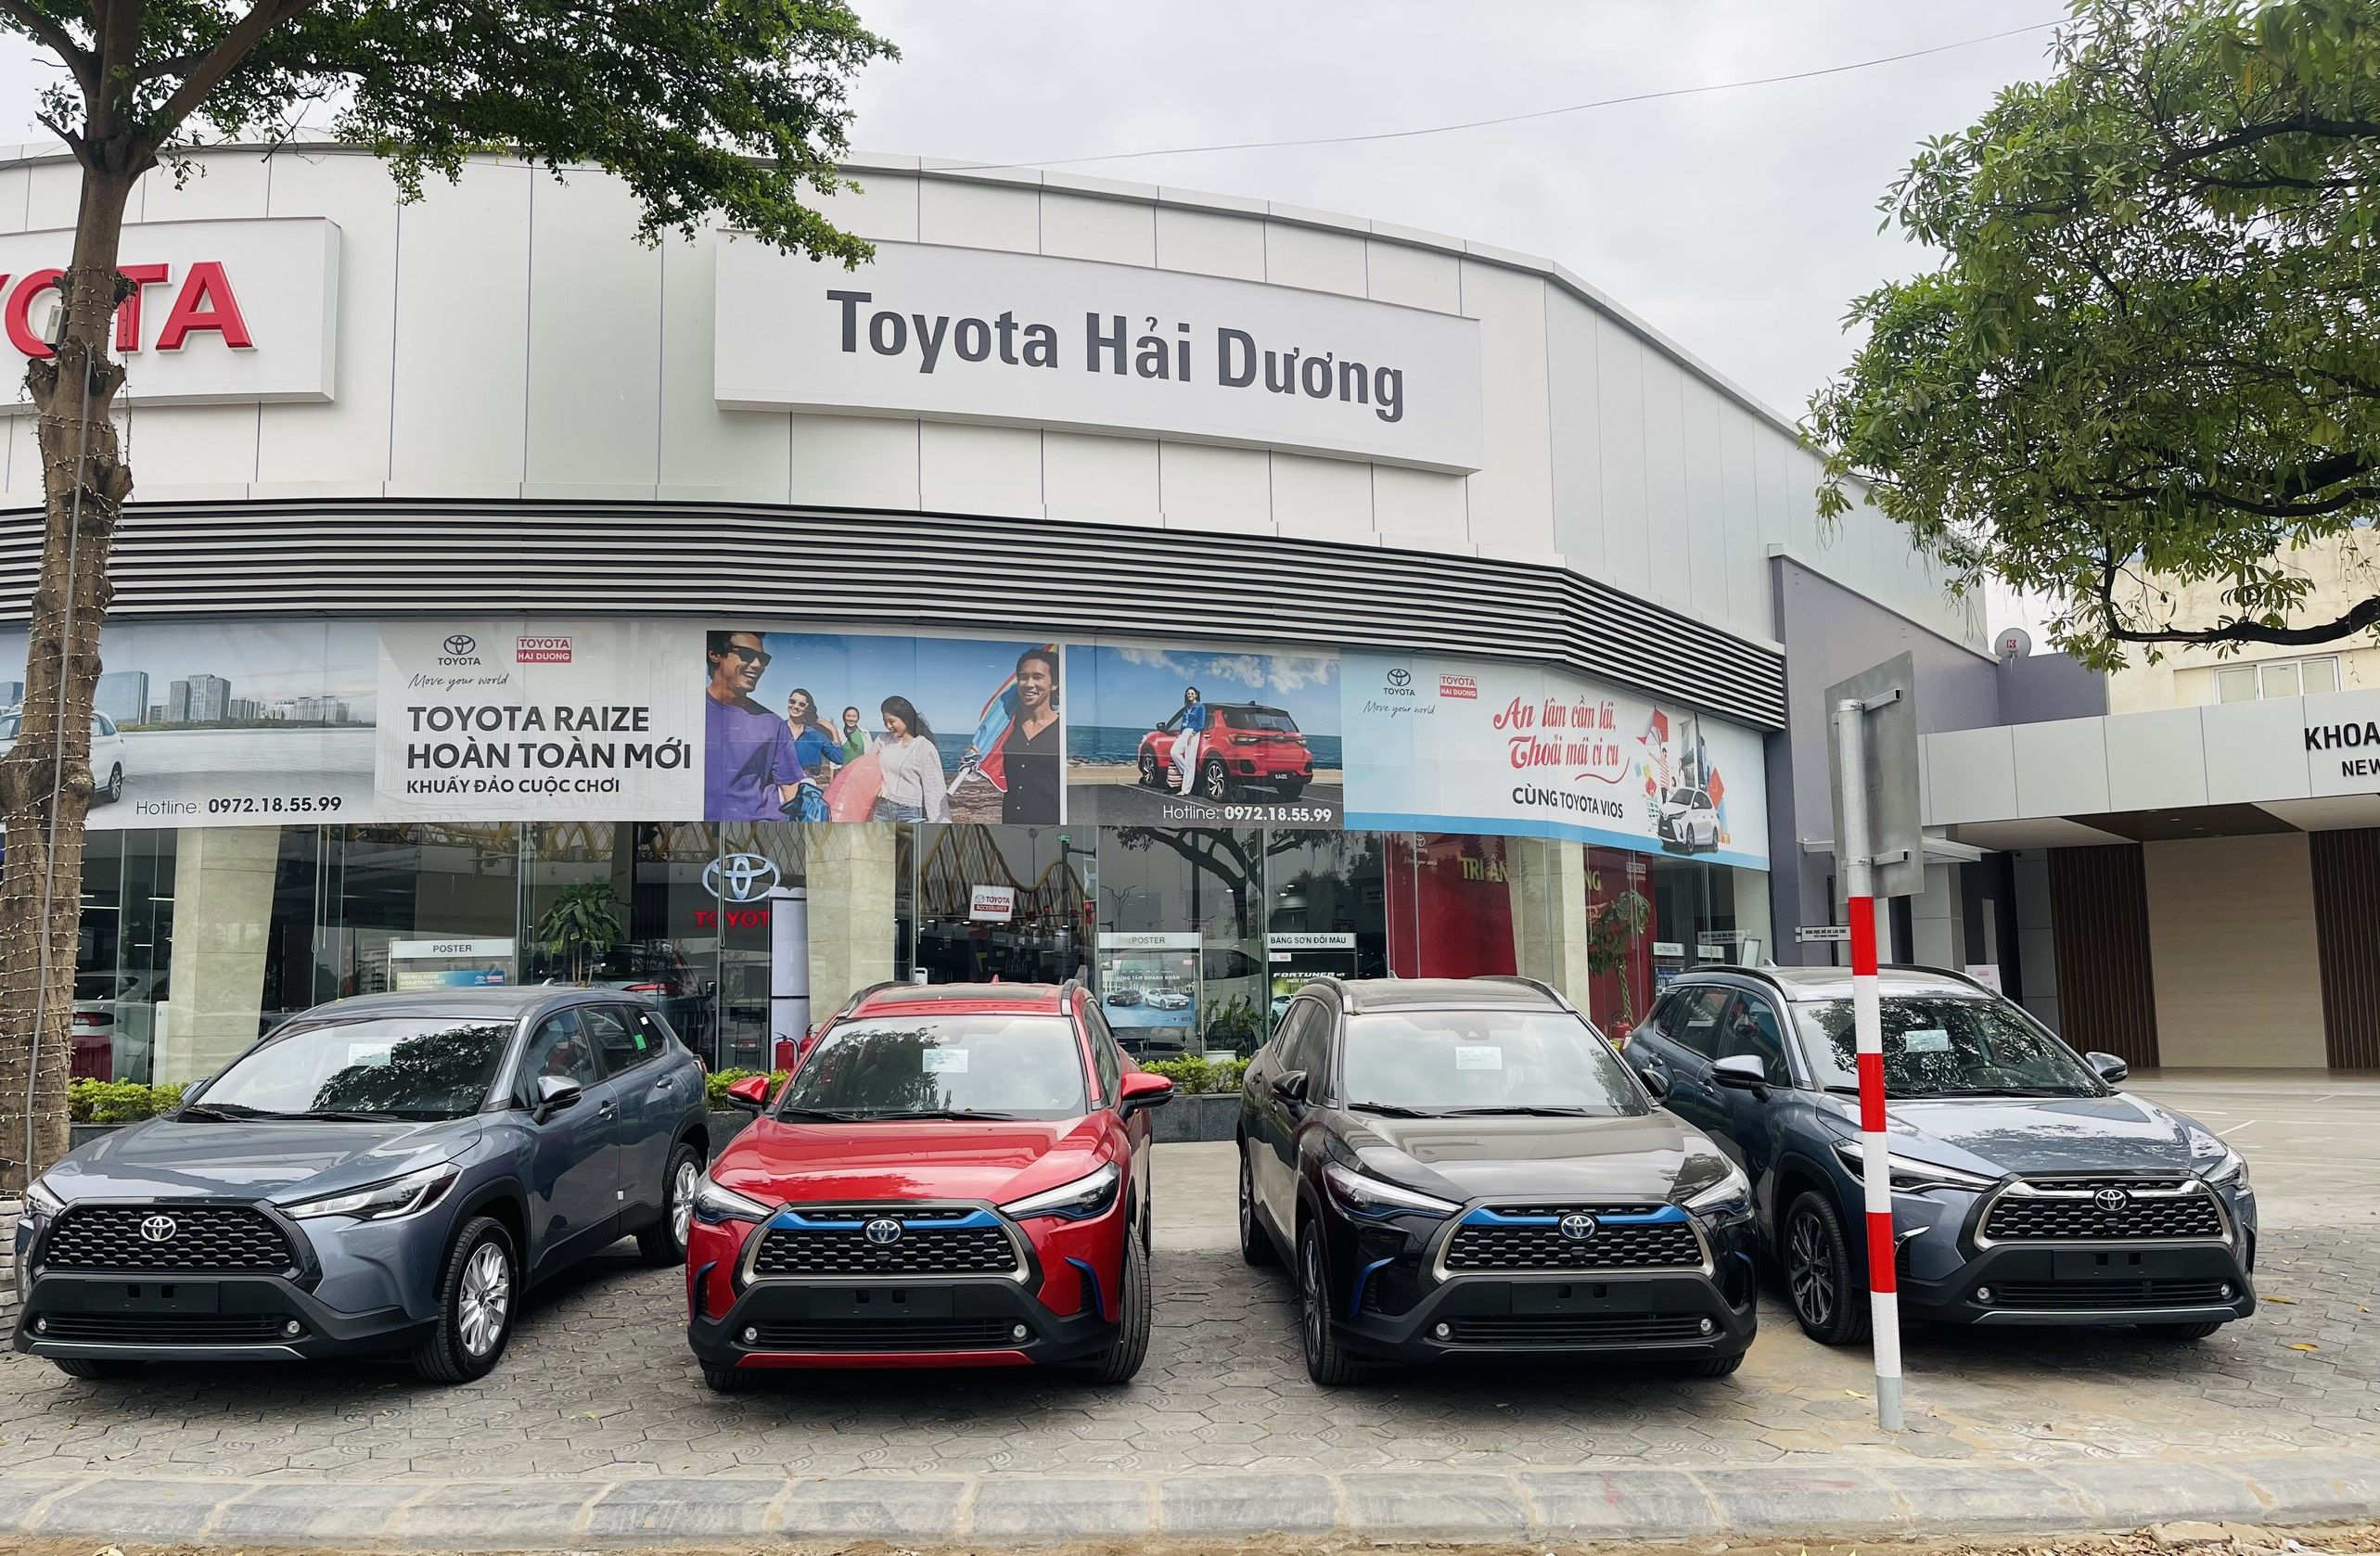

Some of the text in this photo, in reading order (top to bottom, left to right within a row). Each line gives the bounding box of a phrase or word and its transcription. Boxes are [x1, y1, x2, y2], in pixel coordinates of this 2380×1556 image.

[826, 289, 1404, 424] Toyota Hải Dương
[519, 639, 569, 649] TOYOTA
[438, 657, 481, 666] TOYOTA
[518, 652, 570, 660] HAI DUONG
[408, 673, 509, 692] Move your world
[1441, 676, 1476, 686] TOYOTA
[1383, 687, 1415, 696] TOYOTA
[1453, 688, 1477, 697] DUONG
[1363, 700, 1435, 718] Move your world
[1492, 695, 1617, 732] An tâm cầm lái,
[407, 706, 649, 732] TOYOTA RAIZE
[2304, 721, 2380, 751] KHOA
[407, 736, 691, 769] HOÀN TOÀN MỚI
[1509, 733, 1563, 769] Thoải
[1566, 736, 1589, 766] mái
[407, 774, 620, 797] KHUẤY ĐẢO CUỘC CHƠI
[135, 797, 342, 816] Hotline: 0972.18.55.99
[1513, 783, 1623, 819] CÙNG TOYOTA VIOS
[1163, 804, 1332, 823] Hotline: 0972.18.55.99
[986, 896, 1010, 904] TOYOTA
[693, 910, 769, 928] TOYOT
[432, 944, 472, 953] POSTER
